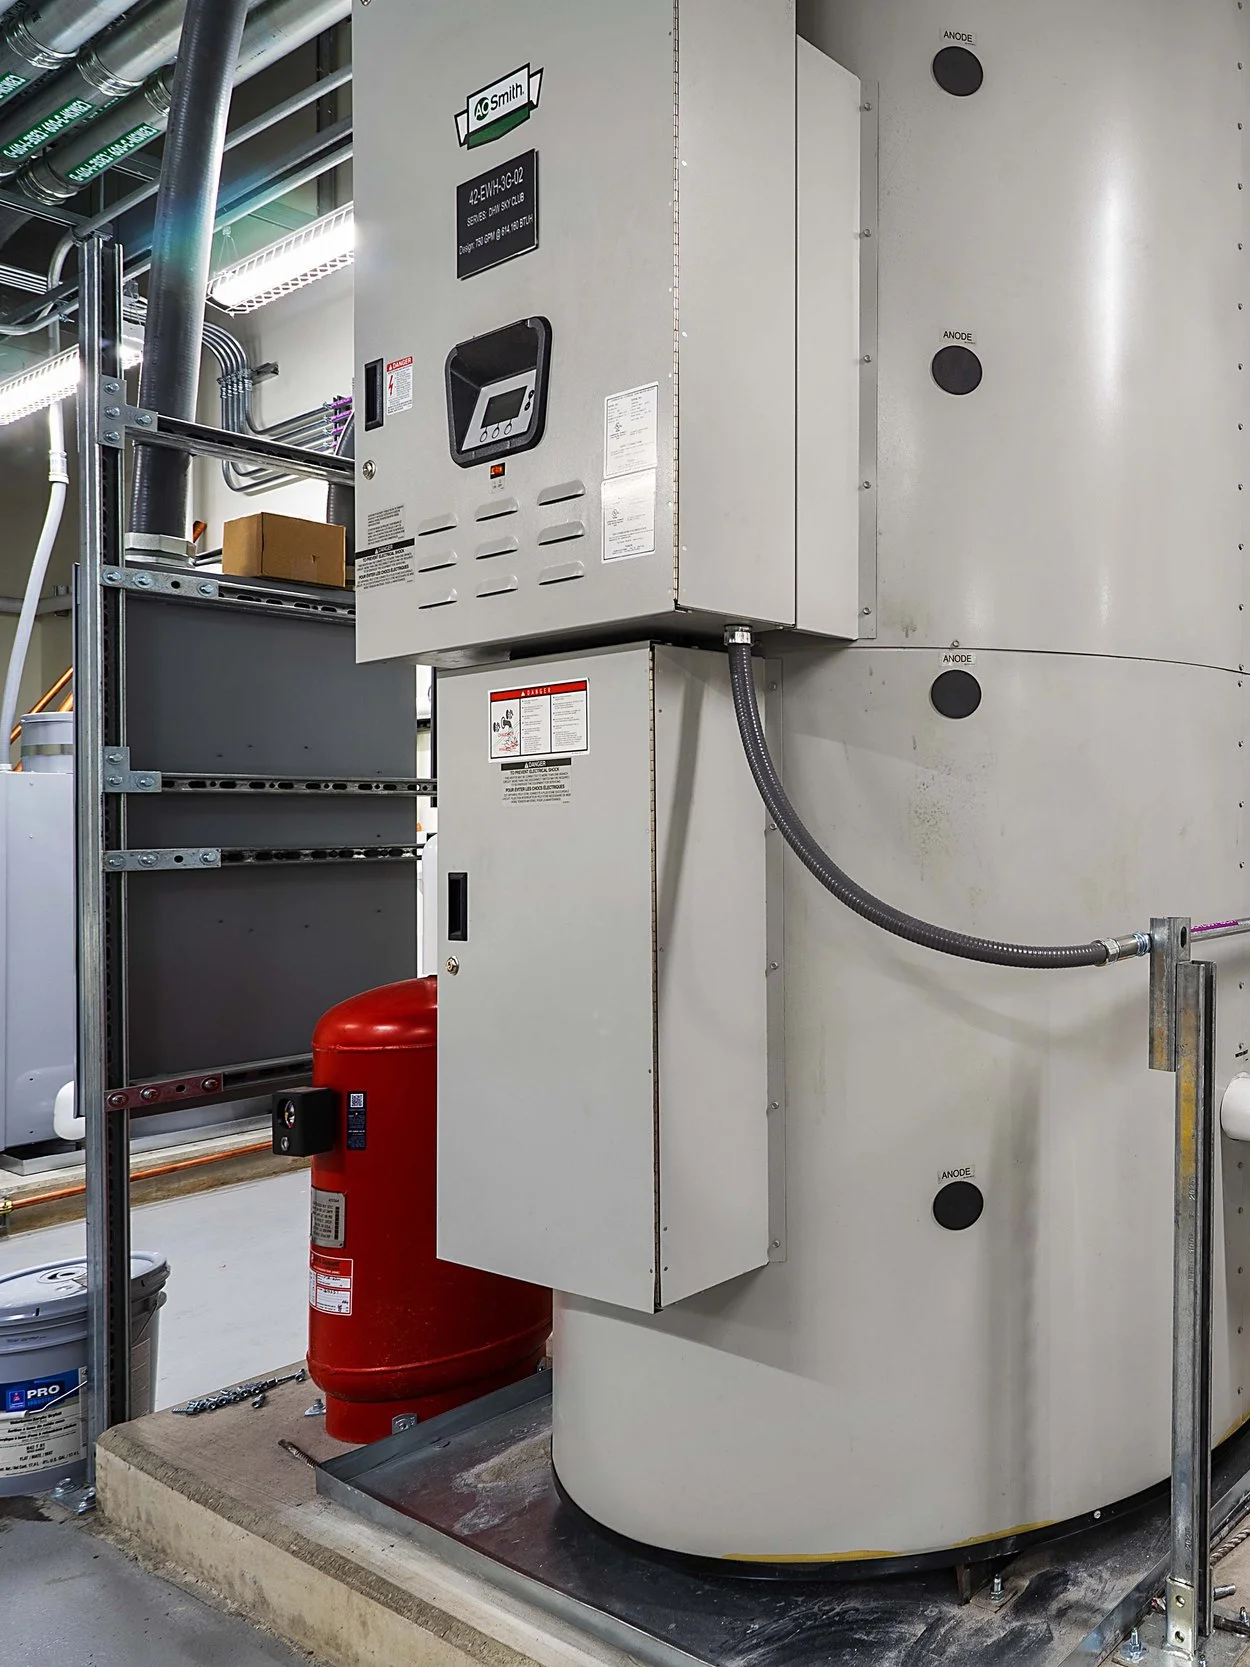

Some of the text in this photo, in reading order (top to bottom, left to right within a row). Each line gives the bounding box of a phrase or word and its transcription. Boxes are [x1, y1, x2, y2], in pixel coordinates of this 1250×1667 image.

[943, 30, 973, 43] ANODE
[469, 166, 524, 205] 42-EWH-3G-02
[467, 209, 487, 227] SERVES:
[501, 197, 511, 212] SKY
[511, 191, 525, 207] CLUB
[484, 230, 495, 245] GPM
[495, 227, 501, 241] @
[519, 213, 533, 230] BTUH
[943, 331, 972, 341] ANODE
[942, 654, 972, 663] ANODE
[527, 687, 552, 696] DANGER
[941, 1167, 971, 1179] ANODE
[26, 1384, 60, 1399] PRO
